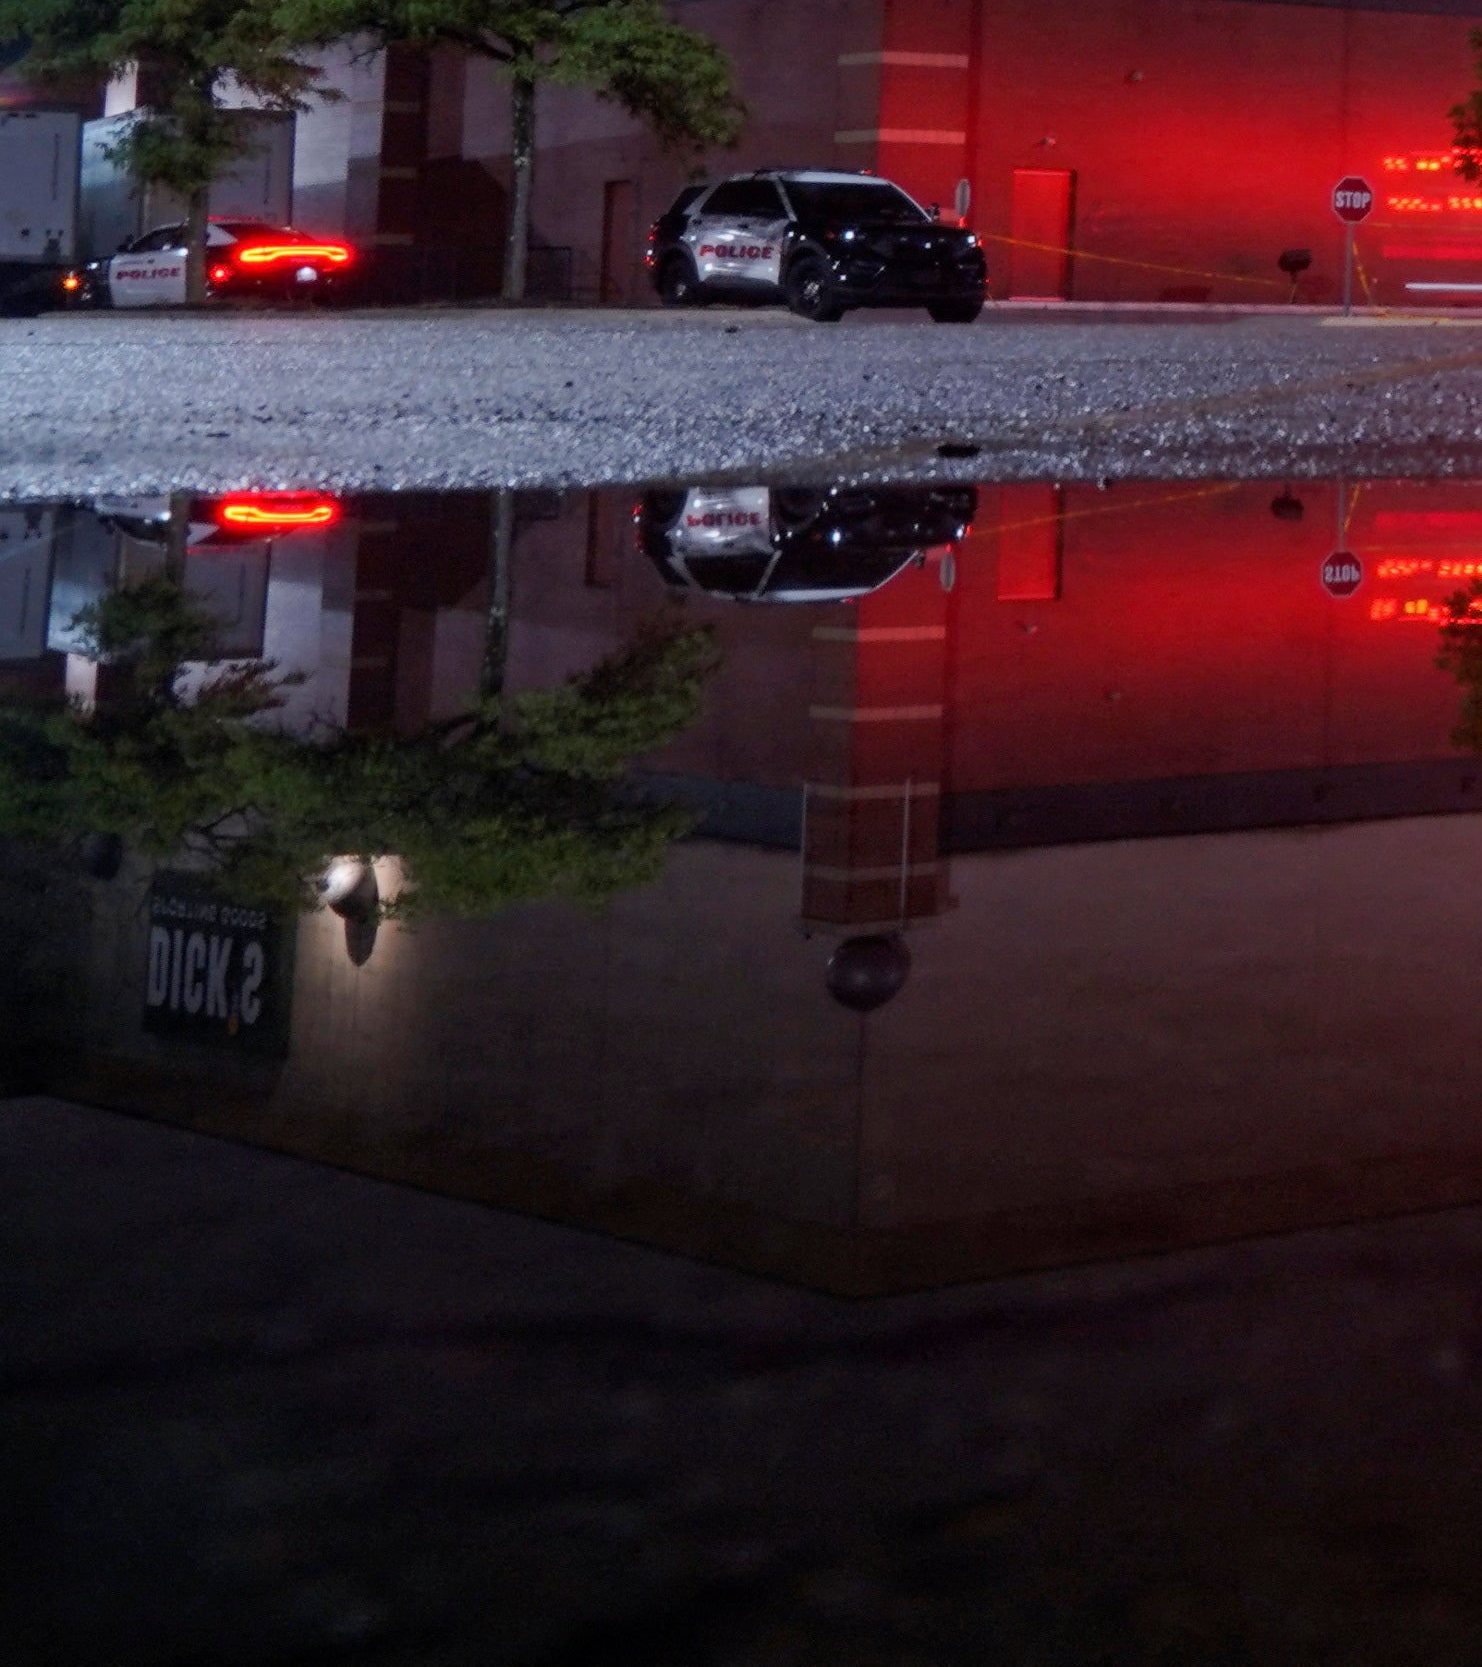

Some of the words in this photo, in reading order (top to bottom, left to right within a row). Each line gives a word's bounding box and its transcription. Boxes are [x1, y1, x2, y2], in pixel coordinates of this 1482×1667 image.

[1335, 191, 1371, 209] STOP
[700, 244, 773, 259] POLICE
[117, 268, 180, 279] POLICE
